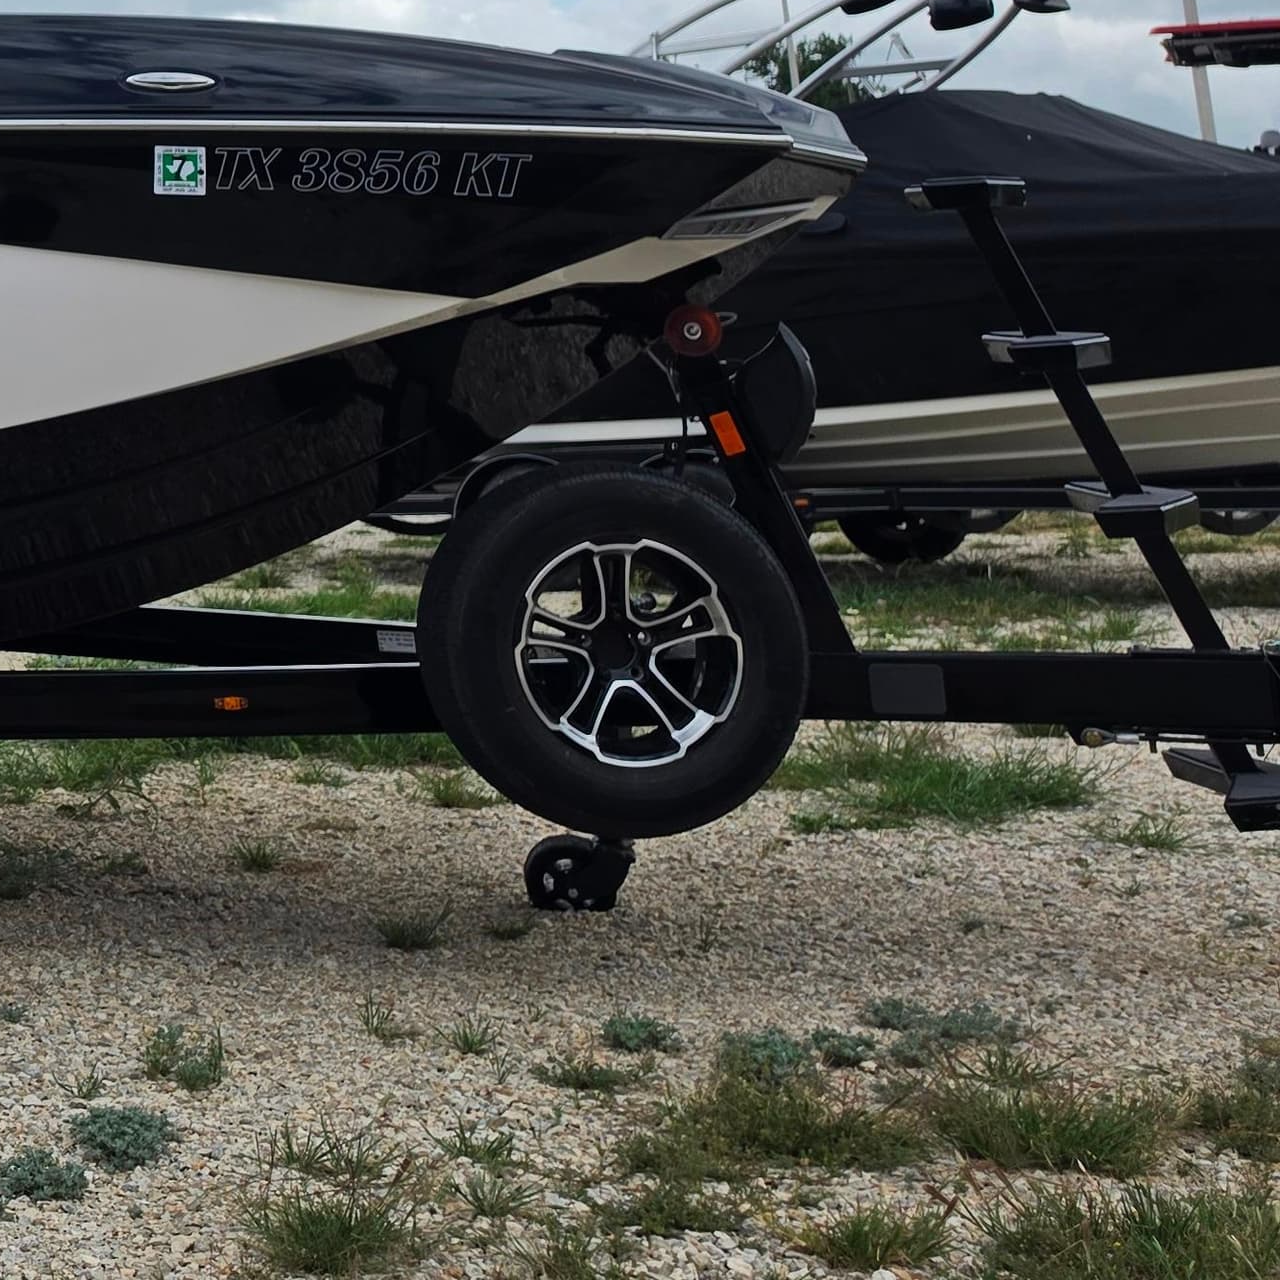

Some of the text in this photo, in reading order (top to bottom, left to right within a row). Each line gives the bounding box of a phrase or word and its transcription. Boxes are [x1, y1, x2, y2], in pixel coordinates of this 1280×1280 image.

[215, 147, 534, 197] TX 3856 KT
